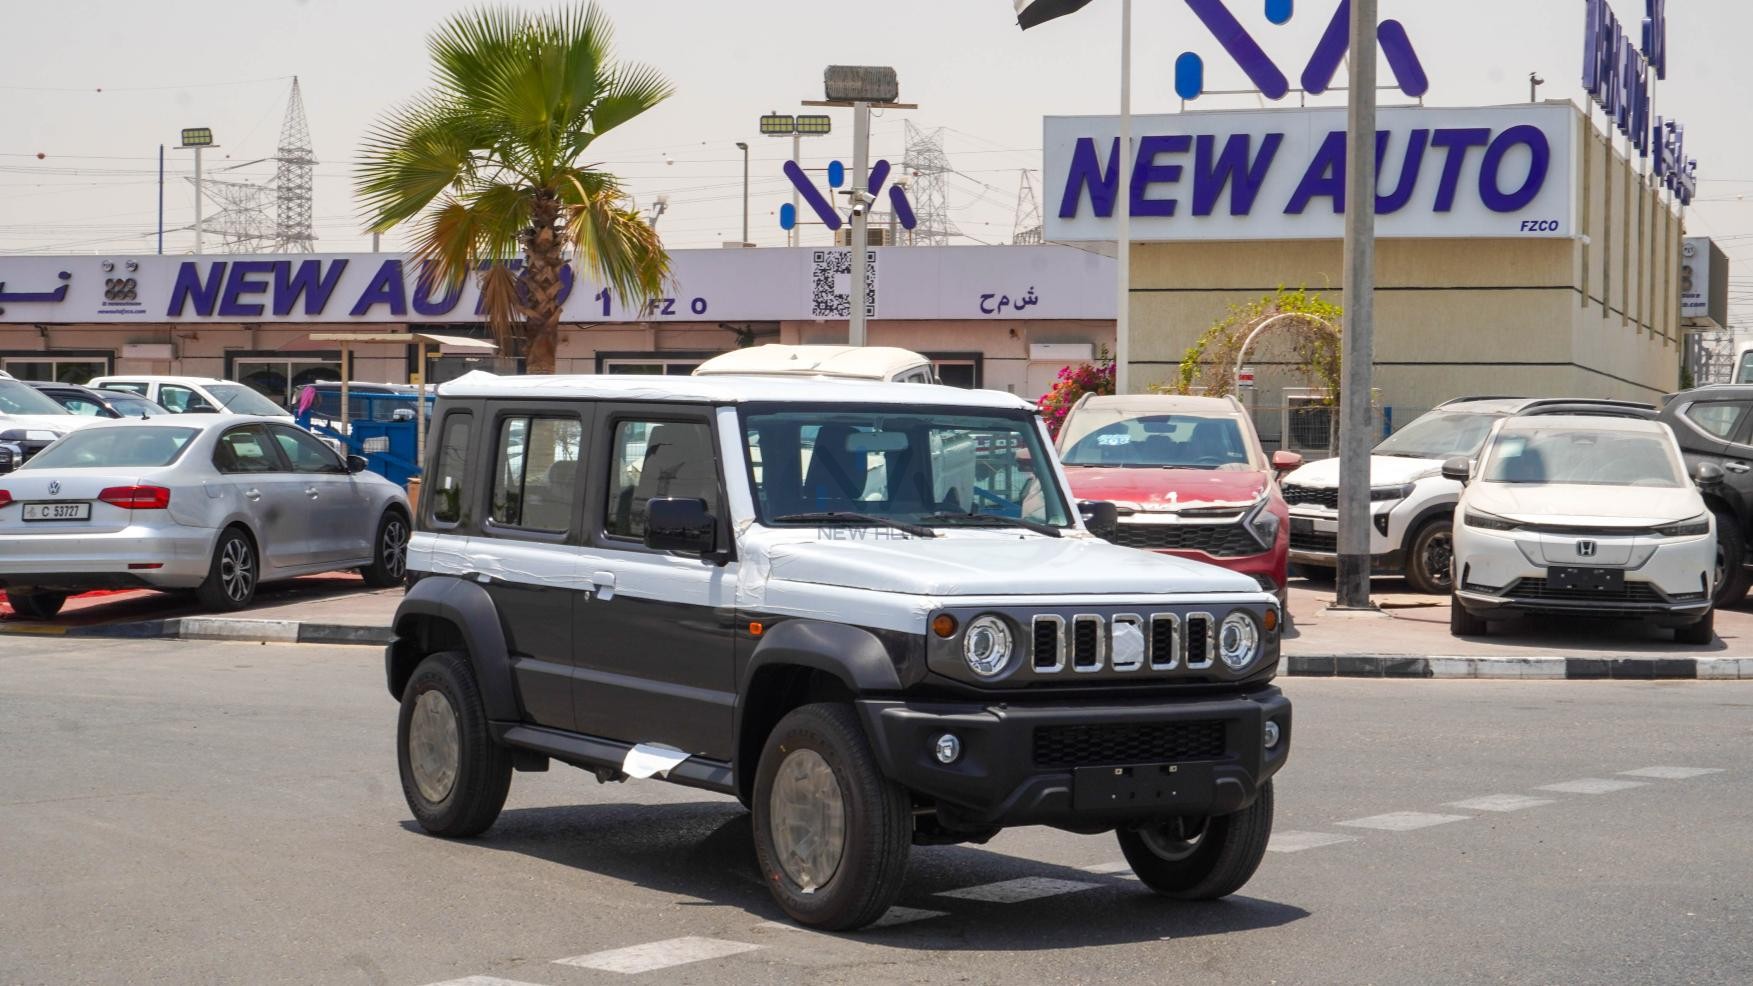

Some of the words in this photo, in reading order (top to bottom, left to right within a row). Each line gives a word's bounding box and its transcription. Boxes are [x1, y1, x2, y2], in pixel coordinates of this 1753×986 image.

[1058, 133, 1281, 218] NEW
[1284, 124, 1551, 217] AUTO
[1520, 221, 1559, 232] FZCO
[168, 260, 346, 316] NEW
[595, 287, 611, 316] 1
[42, 506, 50, 517] C
[53, 505, 80, 517] 53727
